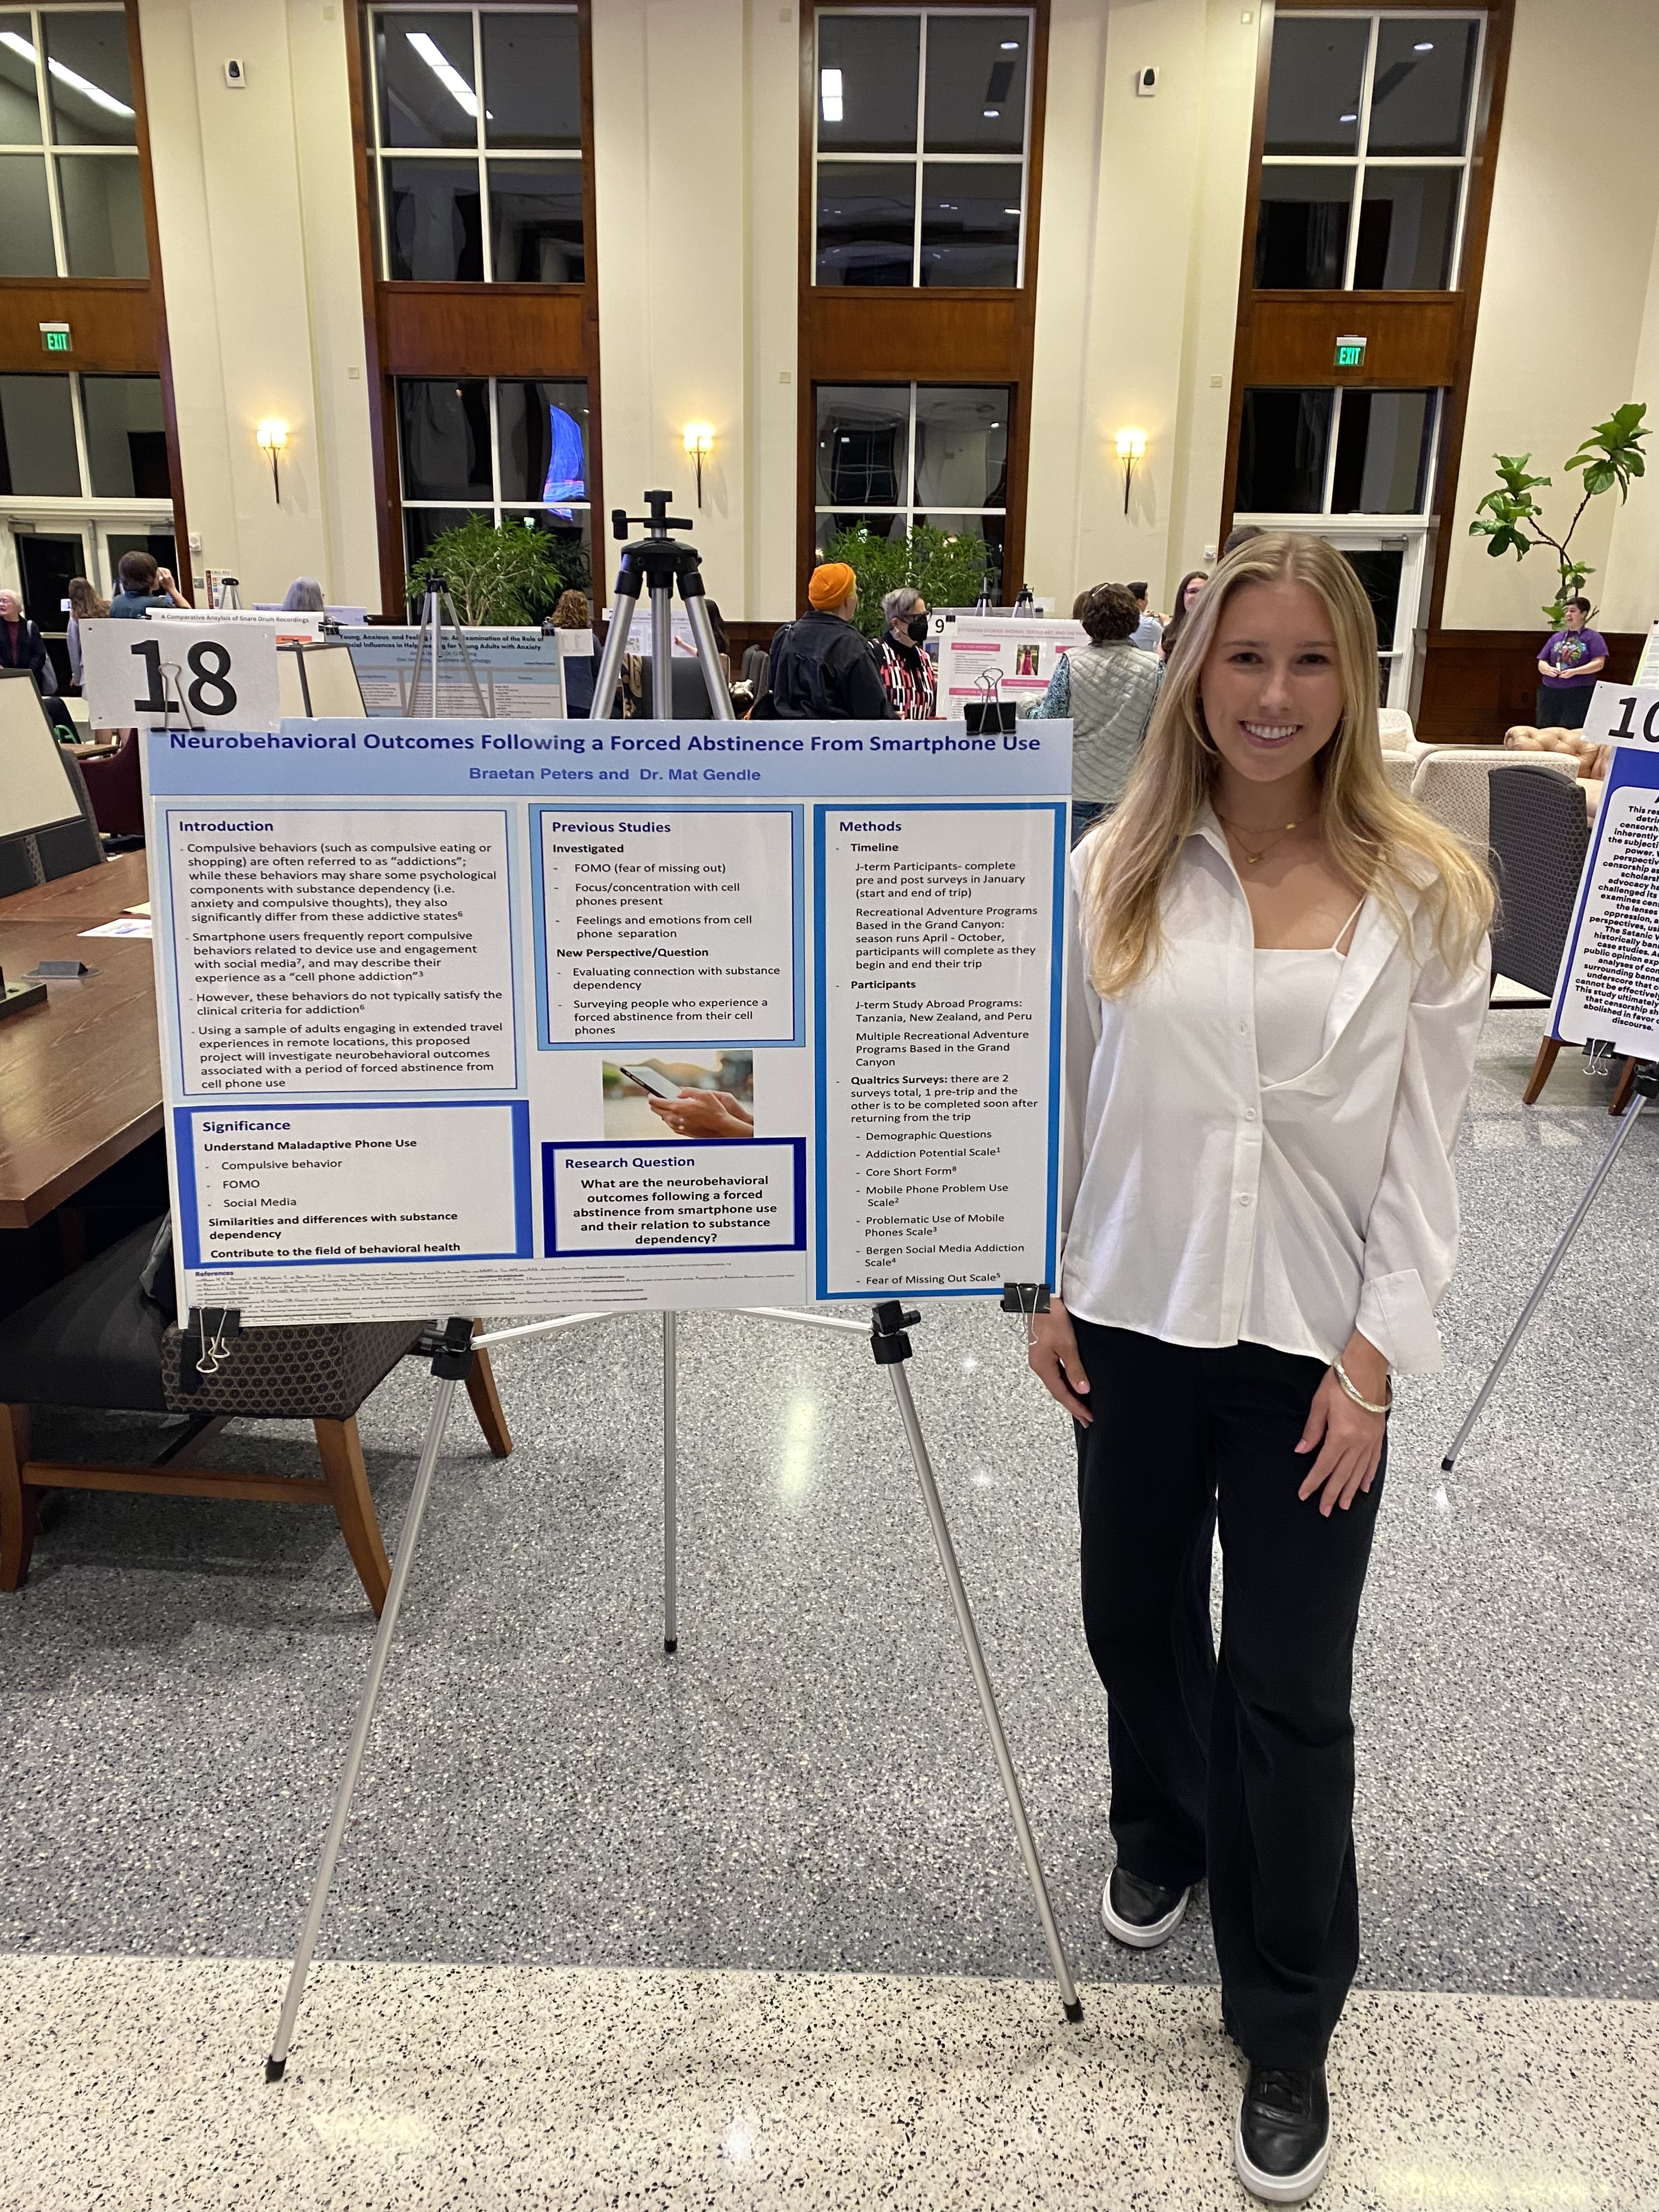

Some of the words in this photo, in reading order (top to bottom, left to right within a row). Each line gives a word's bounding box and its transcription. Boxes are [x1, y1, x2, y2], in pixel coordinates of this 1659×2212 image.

[47, 333, 67, 350] EXIT
[1339, 347, 1361, 364] EXIT
[935, 618, 945, 633] 9
[131, 639, 237, 716] 18
[170, 733, 356, 749] Neurobehavioral
[363, 733, 474, 749] Outcomes
[481, 733, 586, 754] Following
[591, 739, 603, 750] a
[610, 735, 680, 750] Forced
[687, 735, 804, 751] Abstinence
[811, 736, 863, 751] From
[870, 735, 996, 754] Smartphone
[1003, 736, 1040, 750] Use
[469, 767, 534, 779] Braetan
[540, 768, 593, 779] Peters
[598, 768, 629, 780] and
[640, 768, 663, 780] Dr.
[669, 768, 698, 780] Mat
[703, 768, 761, 781] Gendle
[179, 820, 273, 832] Introduction
[552, 821, 614, 832] Previous
[618, 821, 671, 833] Studies
[839, 821, 901, 832] Methods
[1614, 828, 1658, 841] inherently
[187, 843, 256, 854] Compulsive
[259, 843, 317, 852] behaviors
[320, 843, 351, 854] (such
[370, 843, 436, 854] compulsive
[439, 843, 476, 854] eating
[553, 844, 624, 855] Investigated
[850, 843, 899, 852] Timeline
[1625, 847, 1655, 857] power.
[575, 863, 610, 872] FOMO
[614, 863, 641, 874] (fear
[643, 863, 655, 872] of
[658, 863, 700, 874] missing
[703, 863, 726, 874] out)
[1602, 861, 1649, 873] censorship
[575, 882, 690, 893] Focus/concentration
[693, 883, 718, 891] with
[721, 882, 739, 891] cell
[1608, 878, 1649, 890] advocacy
[1598, 884, 1645, 897] challenged
[1646, 890, 1657, 899] its
[575, 896, 617, 907] phones
[620, 897, 663, 907] present
[1600, 893, 1640, 904] examines
[1616, 903, 1630, 911] the
[1632, 905, 1658, 916] lenses
[1605, 925, 1620, 934] The
[1622, 928, 1653, 940] Satanic
[557, 948, 583, 957] New
[586, 947, 709, 959] Perspective/Question
[1584, 947, 1610, 957] public
[1611, 952, 1642, 963] opinion
[851, 980, 916, 990] Participants
[197, 993, 253, 1002] However,
[256, 992, 289, 1001] these
[292, 991, 349, 1001] behaviors
[351, 991, 367, 1000] do
[370, 992, 390, 1000] not
[393, 990, 441, 1002] typically
[444, 990, 480, 1001] satisfy
[483, 990, 502, 999] the
[1583, 1003, 1623, 1017] abolished
[1623, 1009, 1632, 1018] in
[1633, 1013, 1655, 1024] favor
[1612, 1018, 1654, 1032] discourse.
[203, 1120, 290, 1133] Significance
[866, 1131, 937, 1142] Demographic
[939, 1130, 992, 1139] Questions
[204, 1141, 274, 1152] Understand
[277, 1140, 351, 1151] Maladaptive
[355, 1139, 392, 1148] Phone
[395, 1139, 417, 1147] Use
[221, 1160, 288, 1171] Compulsive
[292, 1159, 343, 1168] behavior
[565, 1157, 628, 1169] Research
[632, 1156, 694, 1169] Question
[223, 1180, 260, 1189] FOMO
[580, 1179, 615, 1188] What
[642, 1177, 663, 1187] the
[666, 1175, 768, 1187] neurobehavioral
[866, 1185, 903, 1194] Mobile
[906, 1185, 939, 1193] Phone
[942, 1183, 985, 1193] Problem
[989, 1183, 1008, 1192] Use
[587, 1194, 648, 1203] outcomes
[651, 1191, 710, 1202] following
[723, 1189, 763, 1199] forced
[223, 1198, 257, 1208] Social
[260, 1197, 296, 1206] Media
[573, 1208, 641, 1217] abstinence
[644, 1206, 674, 1215] from
[677, 1204, 753, 1216] smartphone
[209, 1229, 282, 1241] dependency
[635, 1233, 717, 1246] dependency?
[210, 1249, 273, 1258] Contribute
[292, 1247, 312, 1256] the
[315, 1246, 341, 1255] field
[344, 1245, 356, 1254] of
[359, 1244, 421, 1254] behavioral
[423, 1242, 460, 1252] health
[866, 1247, 903, 1256] Bergen
[905, 1244, 935, 1254] Social
[939, 1244, 971, 1253] Media
[974, 1243, 1024, 1252] Addiction
